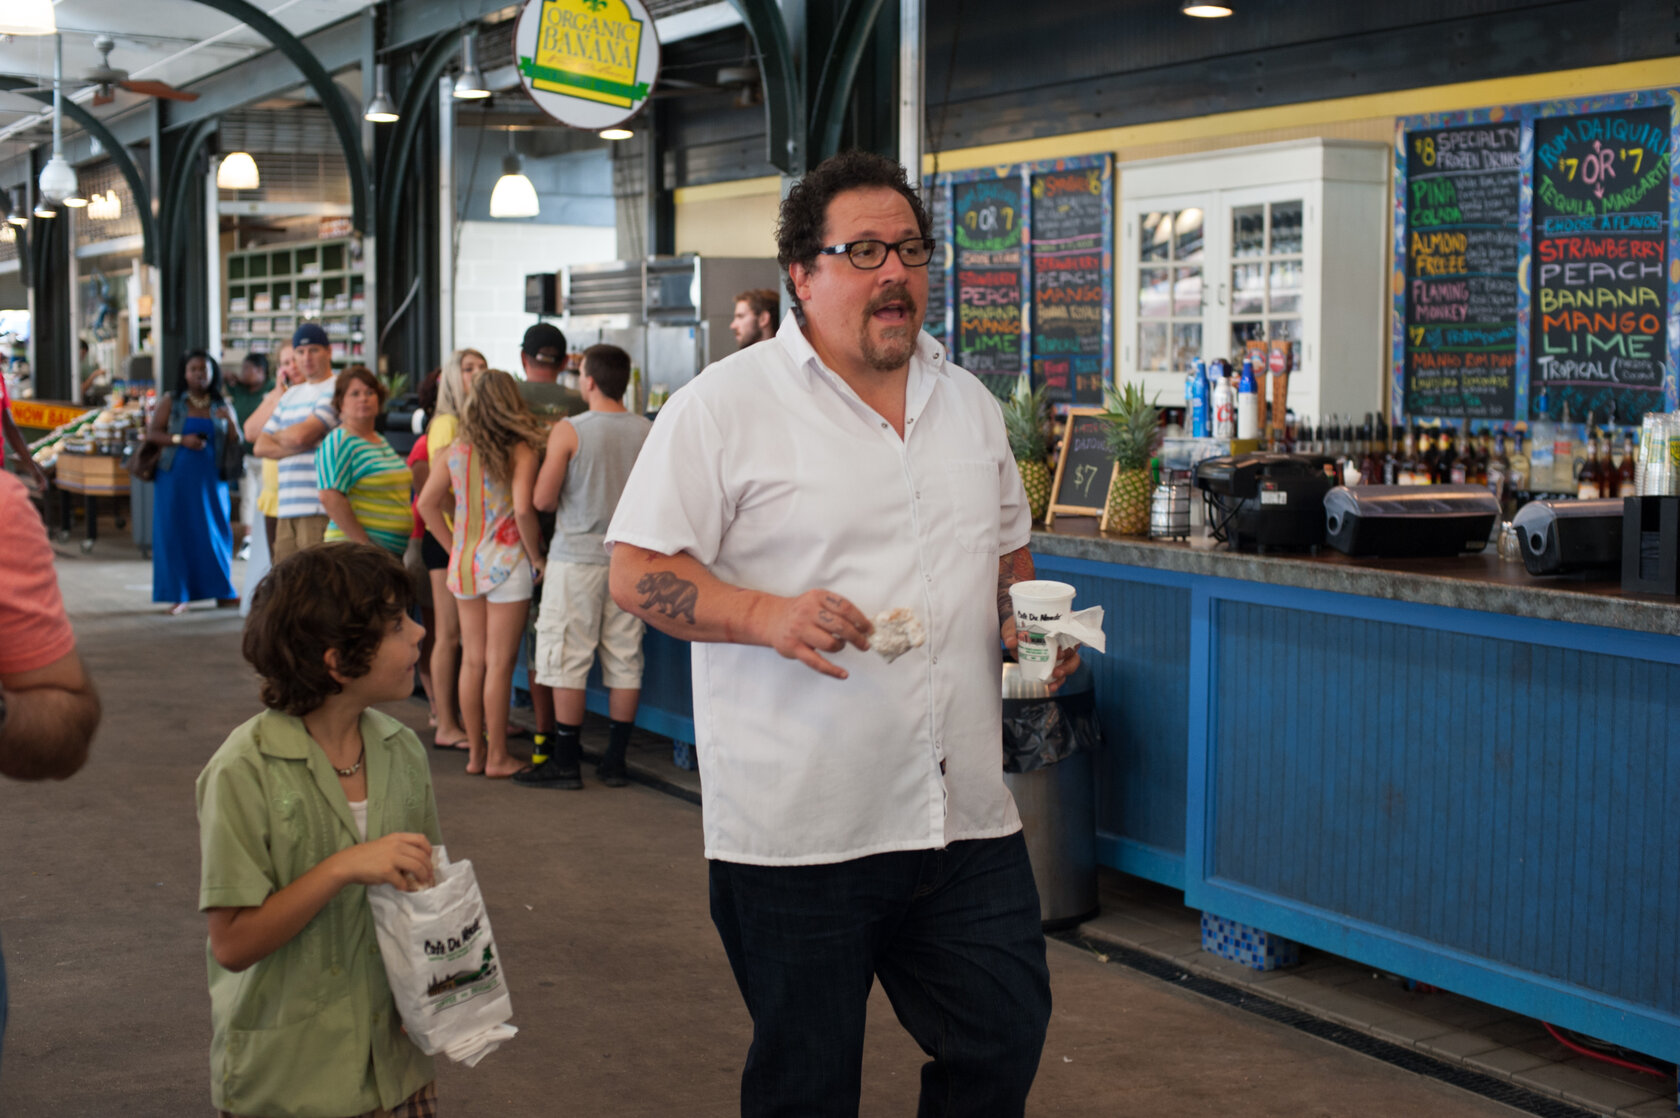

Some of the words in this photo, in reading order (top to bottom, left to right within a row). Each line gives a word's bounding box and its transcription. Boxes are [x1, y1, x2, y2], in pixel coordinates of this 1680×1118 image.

[547, 7, 636, 43] ORGANIC
[543, 26, 632, 69] BANANA
[1437, 128, 1519, 151] SPECIALTY
[1538, 126, 1578, 170] RUM
[1437, 151, 1480, 169] FROZEN
[1582, 149, 1616, 184] OR
[1539, 174, 1596, 217] TEQUILA
[1411, 231, 1467, 259] ALMOND
[1538, 237, 1664, 262] STRAWBERRY
[1540, 261, 1663, 287] PEACH
[960, 286, 1020, 306] PEACH
[1413, 279, 1469, 304] FLAMING
[1540, 286, 1661, 313] BANANA
[1416, 303, 1468, 322] MONKEY
[1543, 310, 1660, 334] MANGO
[960, 333, 1018, 353] LIME
[1543, 332, 1654, 358] LIME
[1537, 355, 1609, 380] TROPICAL
[1074, 464, 1098, 498] $7
